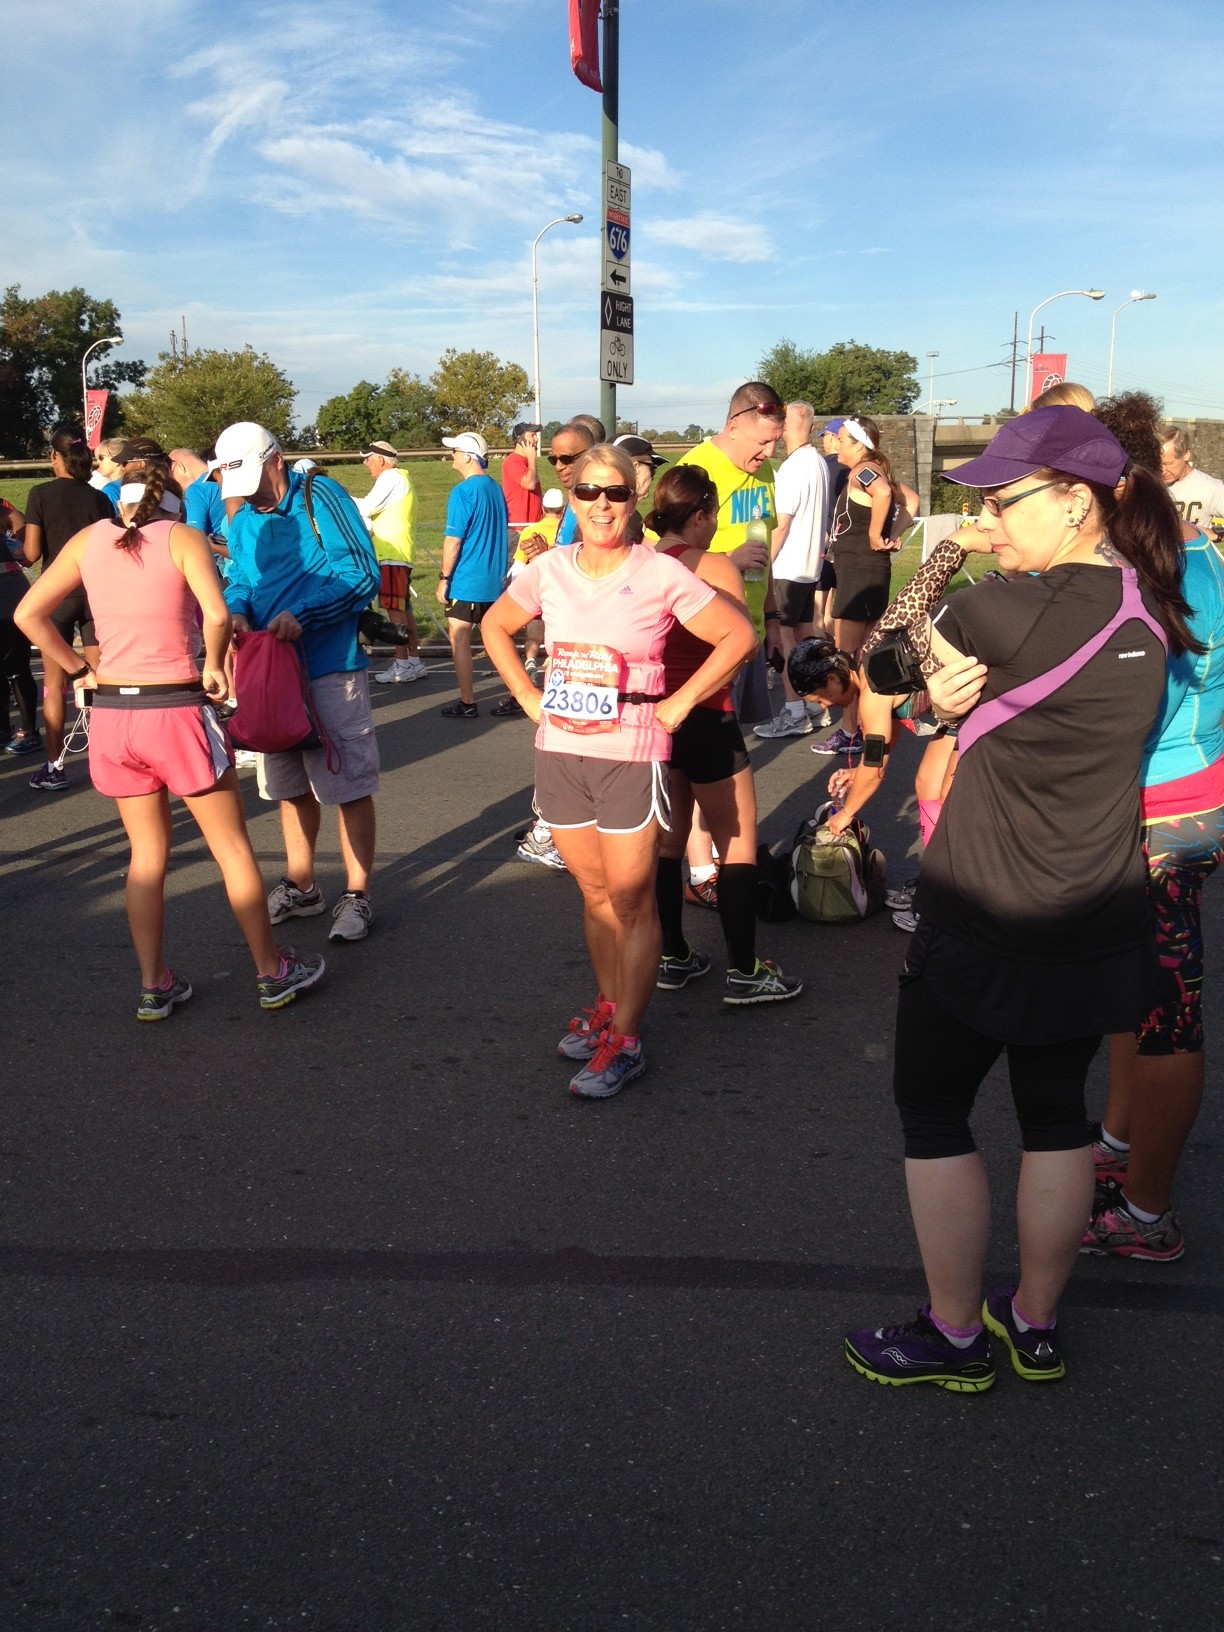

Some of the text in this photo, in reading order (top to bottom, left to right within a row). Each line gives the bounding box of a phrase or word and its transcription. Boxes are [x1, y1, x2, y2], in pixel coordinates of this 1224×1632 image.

[616, 166, 624, 179] TO
[610, 185, 627, 203] EAST
[609, 226, 627, 253] 676
[615, 300, 632, 314] RIGHT
[616, 315, 632, 329] LANE
[606, 360, 628, 379] ONLY
[731, 486, 770, 524] NIKE
[552, 658, 619, 674] PHILADELPHIA
[543, 688, 613, 715] 23806
